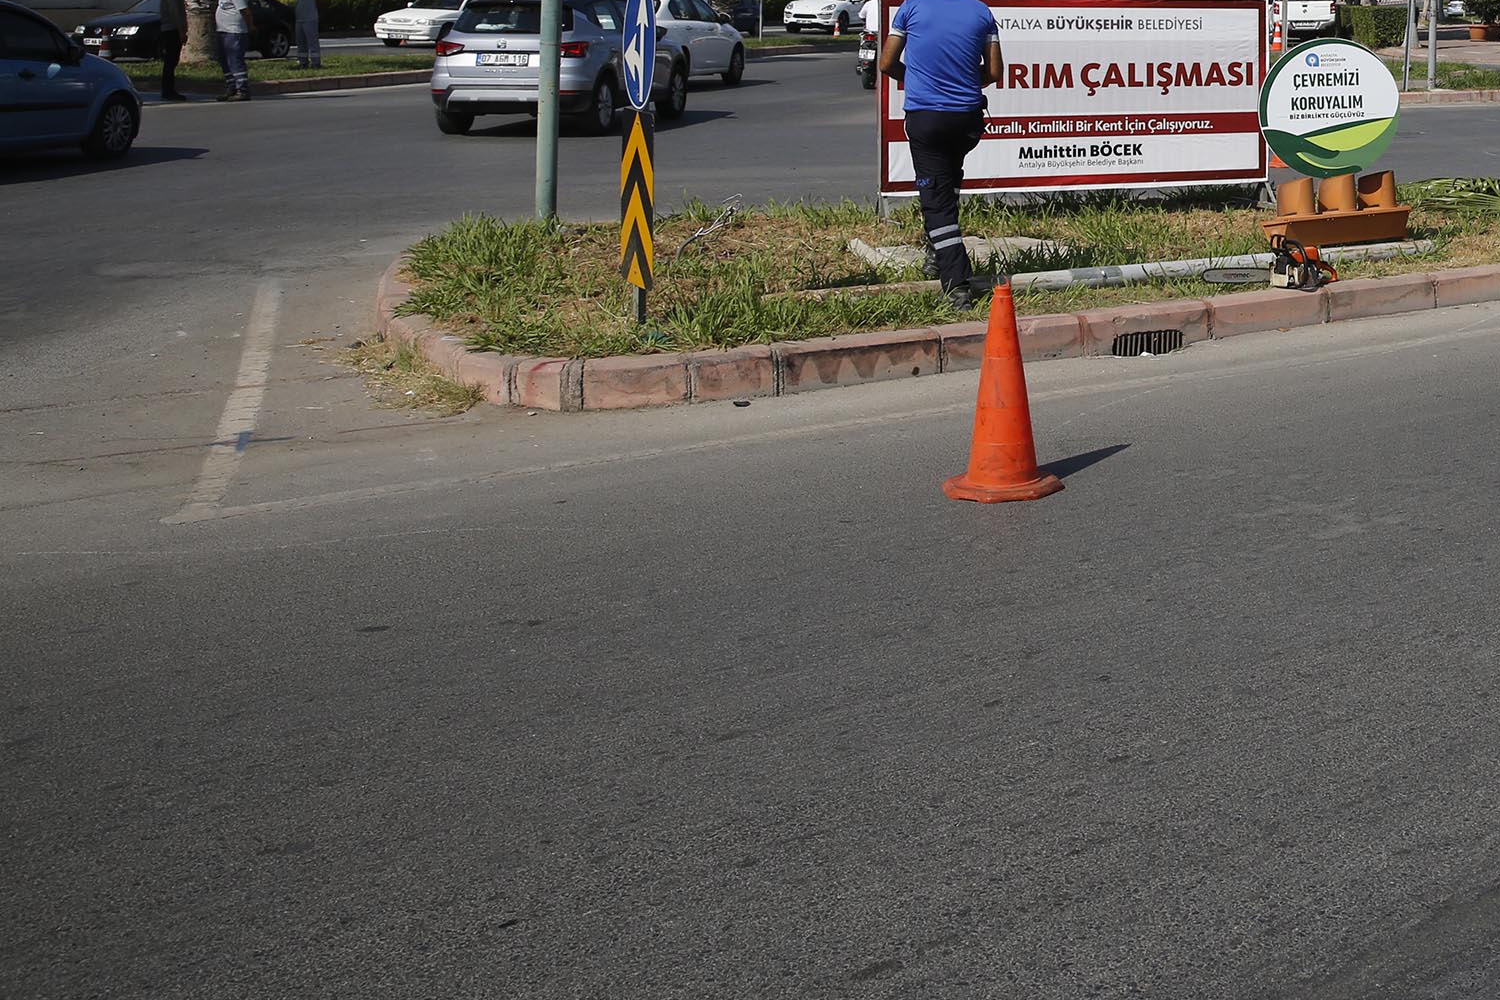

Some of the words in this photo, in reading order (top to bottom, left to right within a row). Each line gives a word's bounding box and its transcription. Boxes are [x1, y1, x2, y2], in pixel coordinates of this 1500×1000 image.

[998, 18, 1042, 30] NTALYA
[1047, 15, 1133, 32] BÜYÜKŞEHİR
[1138, 15, 1203, 31] BELEDİYESİ
[481, 55, 491, 63] 07
[513, 55, 527, 63] 116
[1081, 61, 1253, 97] ÇALIŞMASI
[1293, 68, 1360, 91] ÇEVREMİZİ
[1291, 95, 1363, 111] KORUYALIM
[1301, 112, 1329, 120] BİRLİKTE
[1330, 111, 1365, 119] GÜÇLÜYÜZ
[1028, 120, 1074, 133] Kimlikli
[1076, 119, 1092, 132] Bir
[1095, 119, 1123, 132] Kent
[1125, 117, 1146, 133] İçin
[1148, 118, 1214, 134] Çalışıyoruz.
[1019, 144, 1087, 159] Muhittin
[1090, 141, 1143, 157] BÖCEK
[1019, 159, 1046, 169] Antalya
[1047, 158, 1086, 168] Büyükşehir
[1087, 157, 1116, 167] Belediye
[1118, 156, 1144, 167] Başkanı
